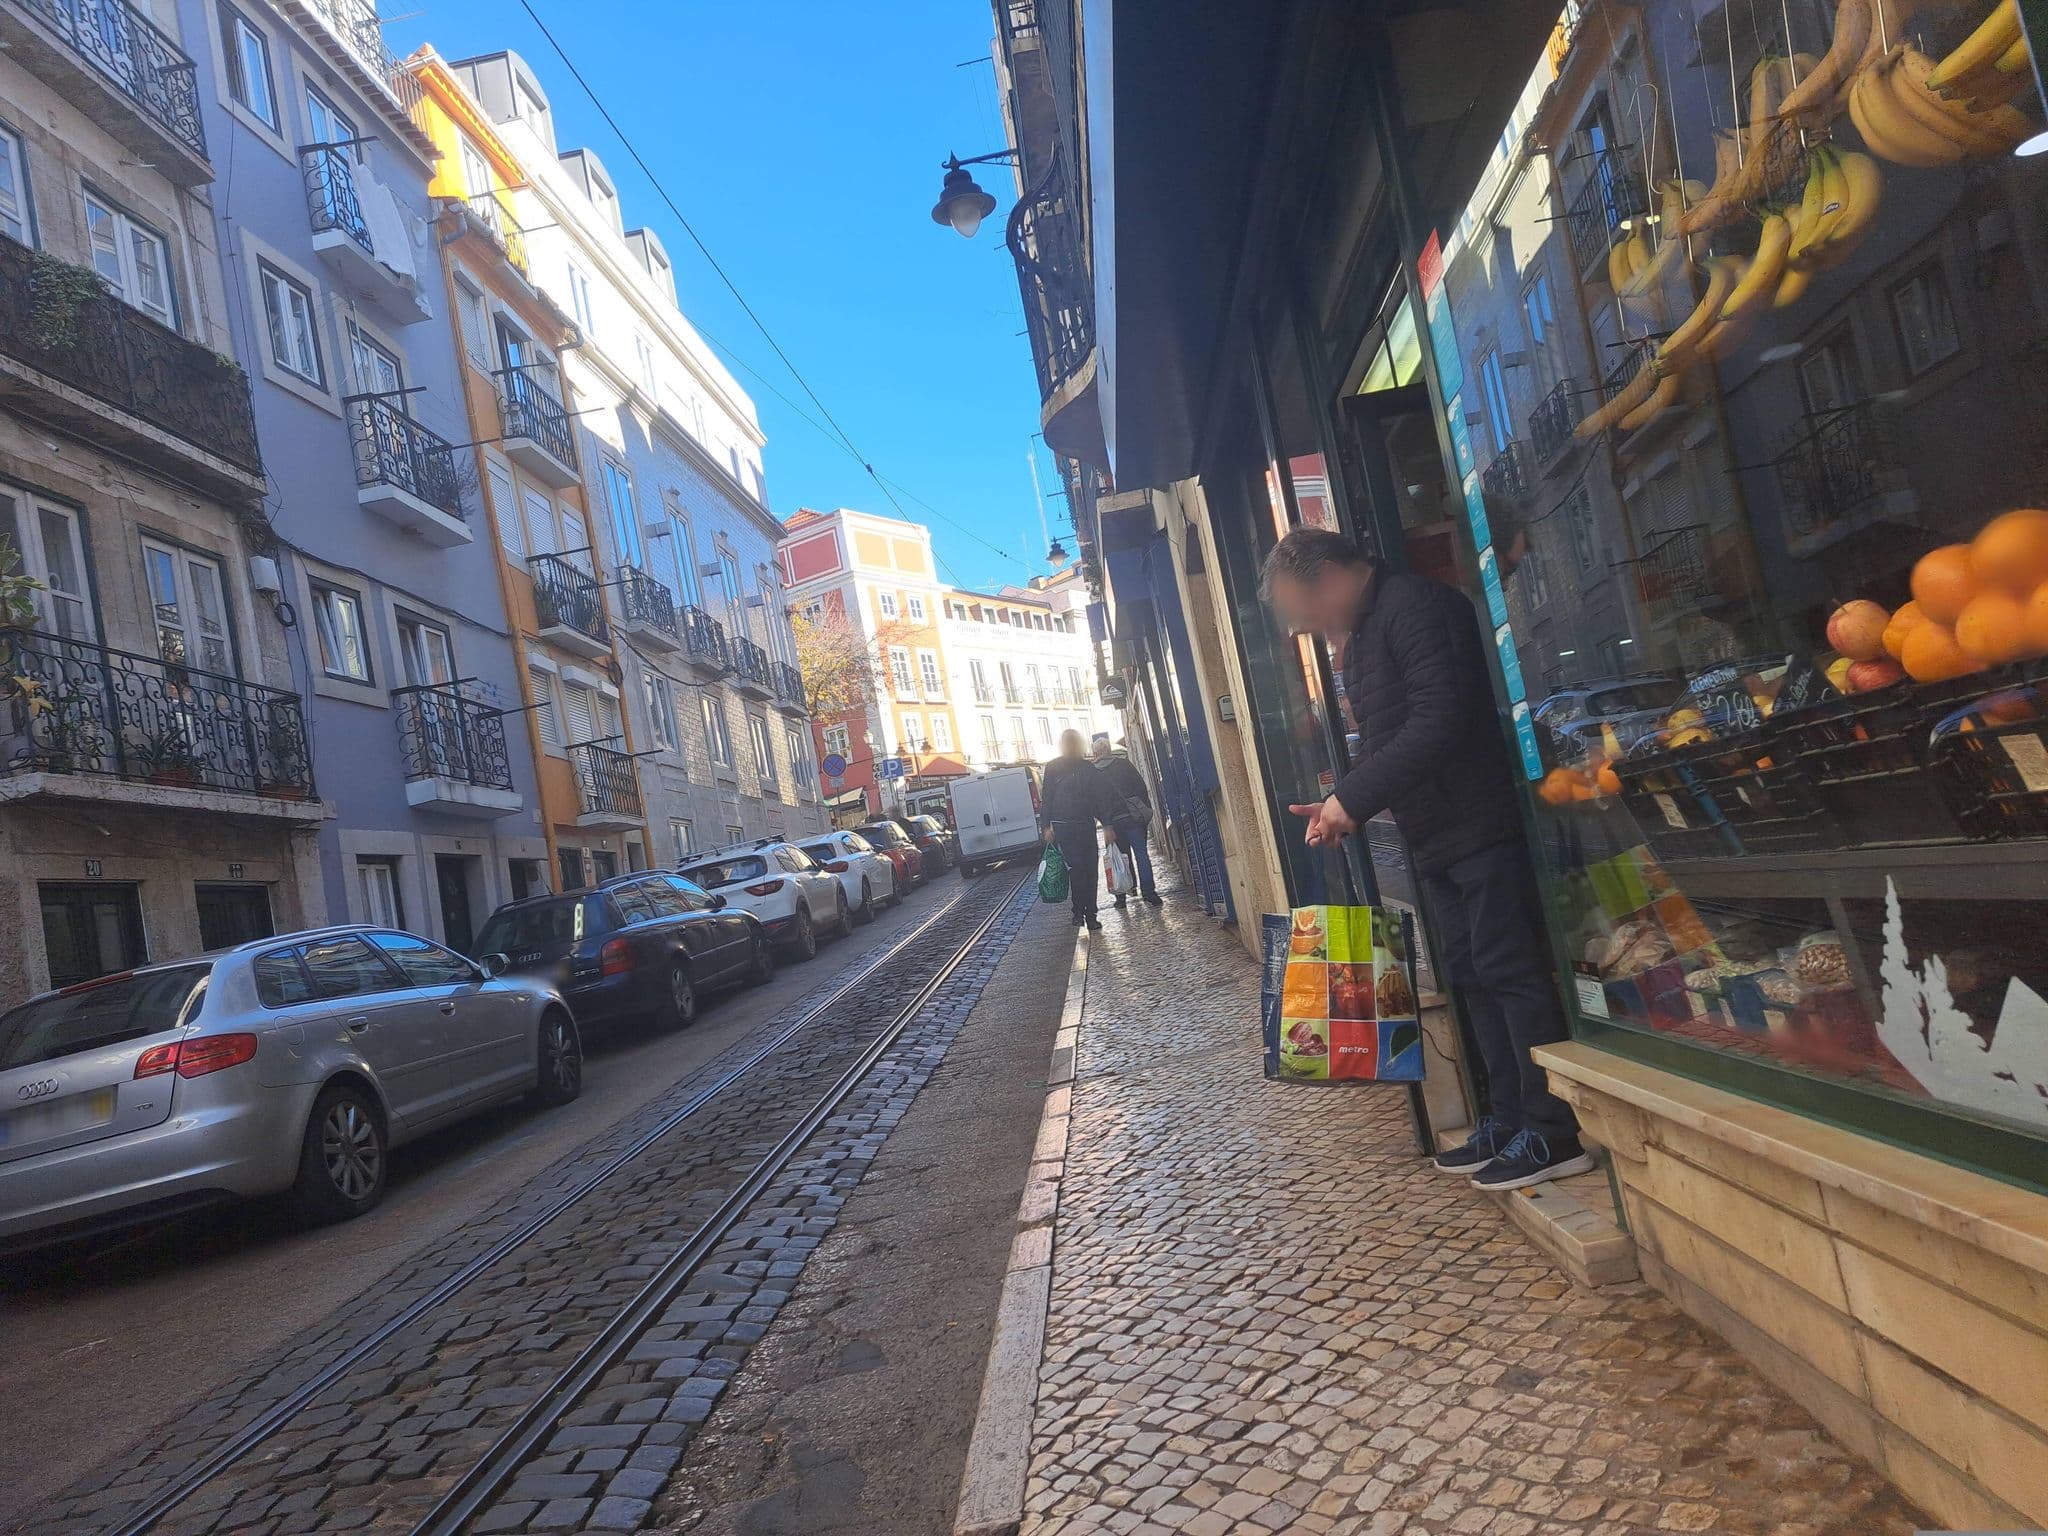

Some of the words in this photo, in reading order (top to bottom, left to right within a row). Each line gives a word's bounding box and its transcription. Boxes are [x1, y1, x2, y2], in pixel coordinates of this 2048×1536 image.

[886, 760, 898, 777] P
[87, 861, 100, 876] 20
[1338, 1046, 1369, 1054] metro
